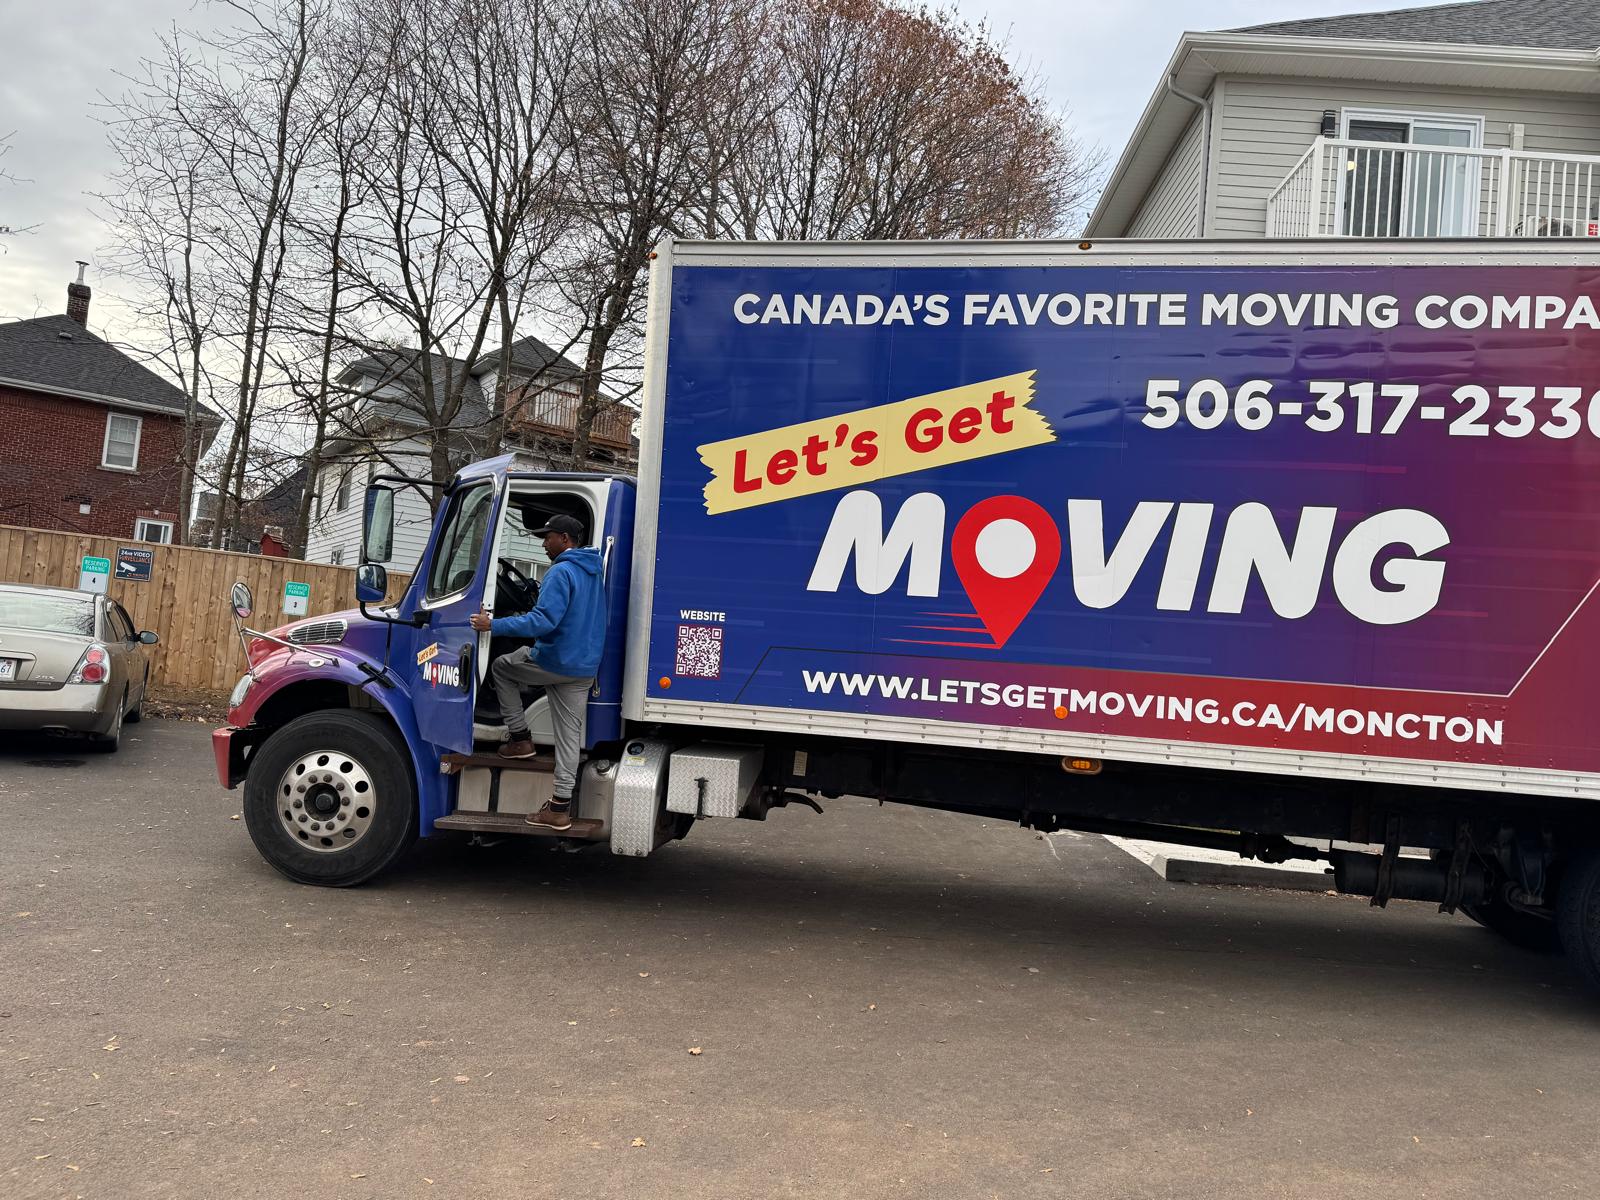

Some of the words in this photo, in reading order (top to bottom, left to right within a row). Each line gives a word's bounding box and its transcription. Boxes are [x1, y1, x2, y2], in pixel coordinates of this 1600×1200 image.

[733, 293, 950, 325] CANADA'S
[963, 293, 1187, 326] FAVORITE
[1201, 293, 1399, 329] MOVING
[1414, 295, 1600, 330] COMPA
[1141, 379, 1600, 440] 506-317-233
[732, 423, 879, 493] Let's
[904, 390, 1015, 453] Get
[84, 560, 108, 568] RESERVED
[85, 564, 106, 573] PARKING
[806, 490, 1450, 649] MOVING
[680, 609, 725, 622] WEBSITE
[423, 662, 459, 688] MOVING
[802, 669, 1503, 746] WWW.LETSGETMOVING.CA/MONCTON
